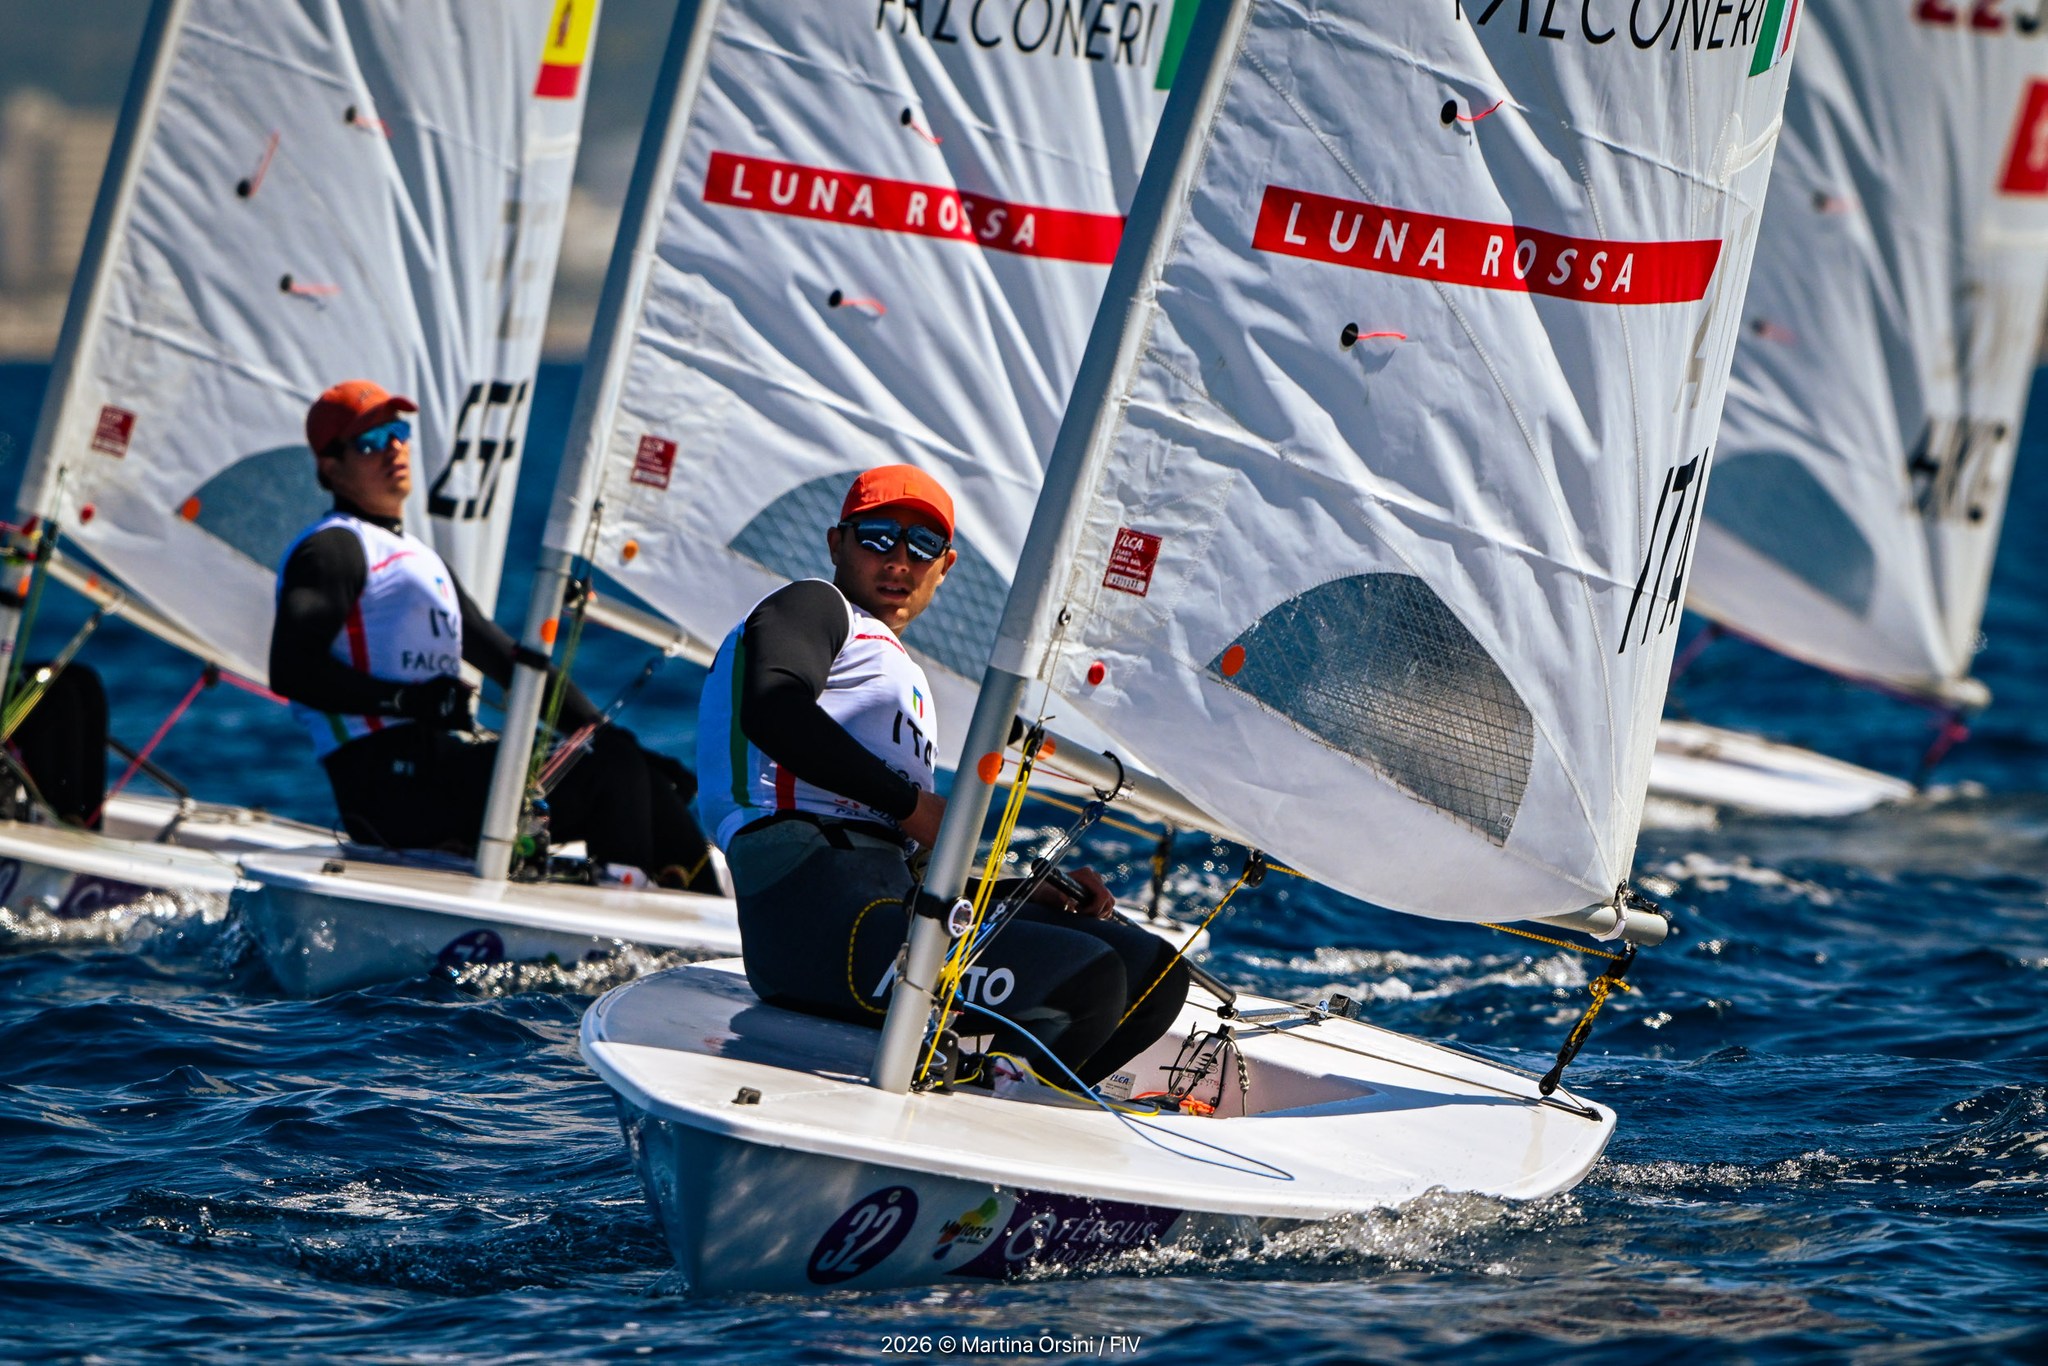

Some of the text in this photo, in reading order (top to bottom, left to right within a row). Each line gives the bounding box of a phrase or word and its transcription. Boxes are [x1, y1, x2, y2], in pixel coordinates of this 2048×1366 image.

[1454, 0, 1763, 51] LCONERI
[730, 164, 1036, 249] LUNA ROSSA
[1283, 202, 1635, 293] LUNA ROSSA
[1119, 534, 1144, 551] ILCA
[1617, 446, 1710, 655] ITA
[429, 607, 458, 639] IT
[892, 709, 933, 770] ITA
[815, 1203, 903, 1273] 32
